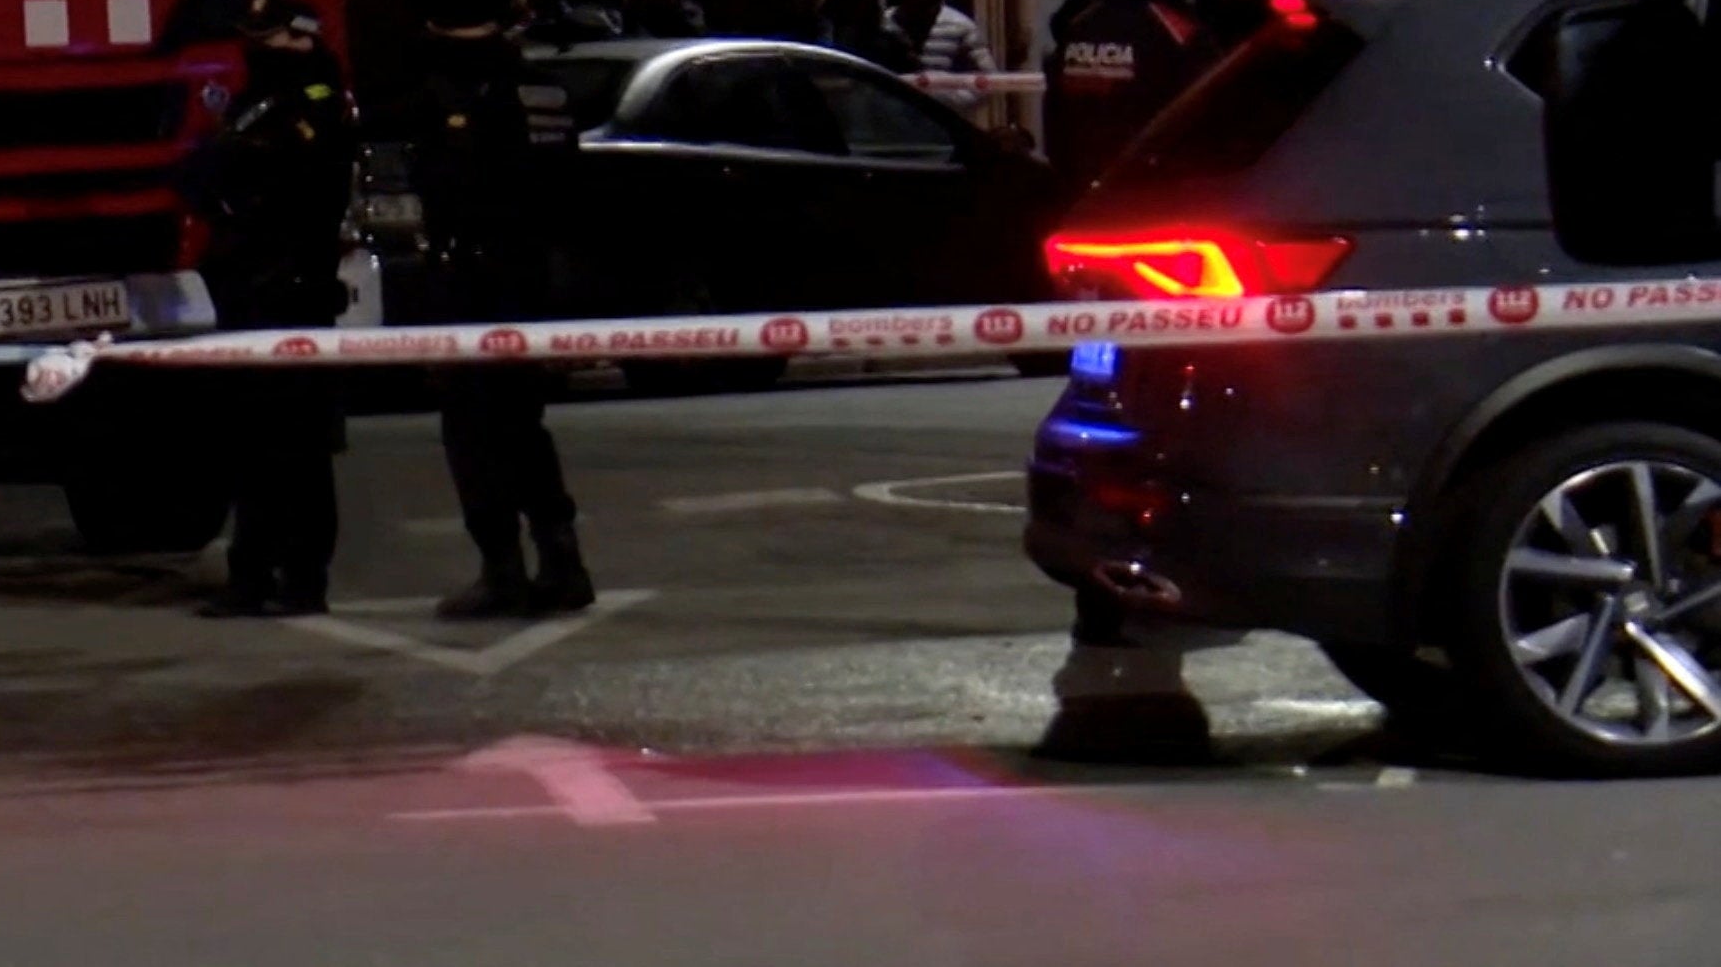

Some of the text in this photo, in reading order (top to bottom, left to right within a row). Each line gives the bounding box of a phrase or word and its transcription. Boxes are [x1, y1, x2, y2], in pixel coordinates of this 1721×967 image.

[63, 287, 120, 320] LNH
[1047, 313, 1094, 335] NO
[1108, 306, 1244, 332] PASSEU
[1563, 286, 1613, 310] NO
[1627, 280, 1721, 308] PASS
